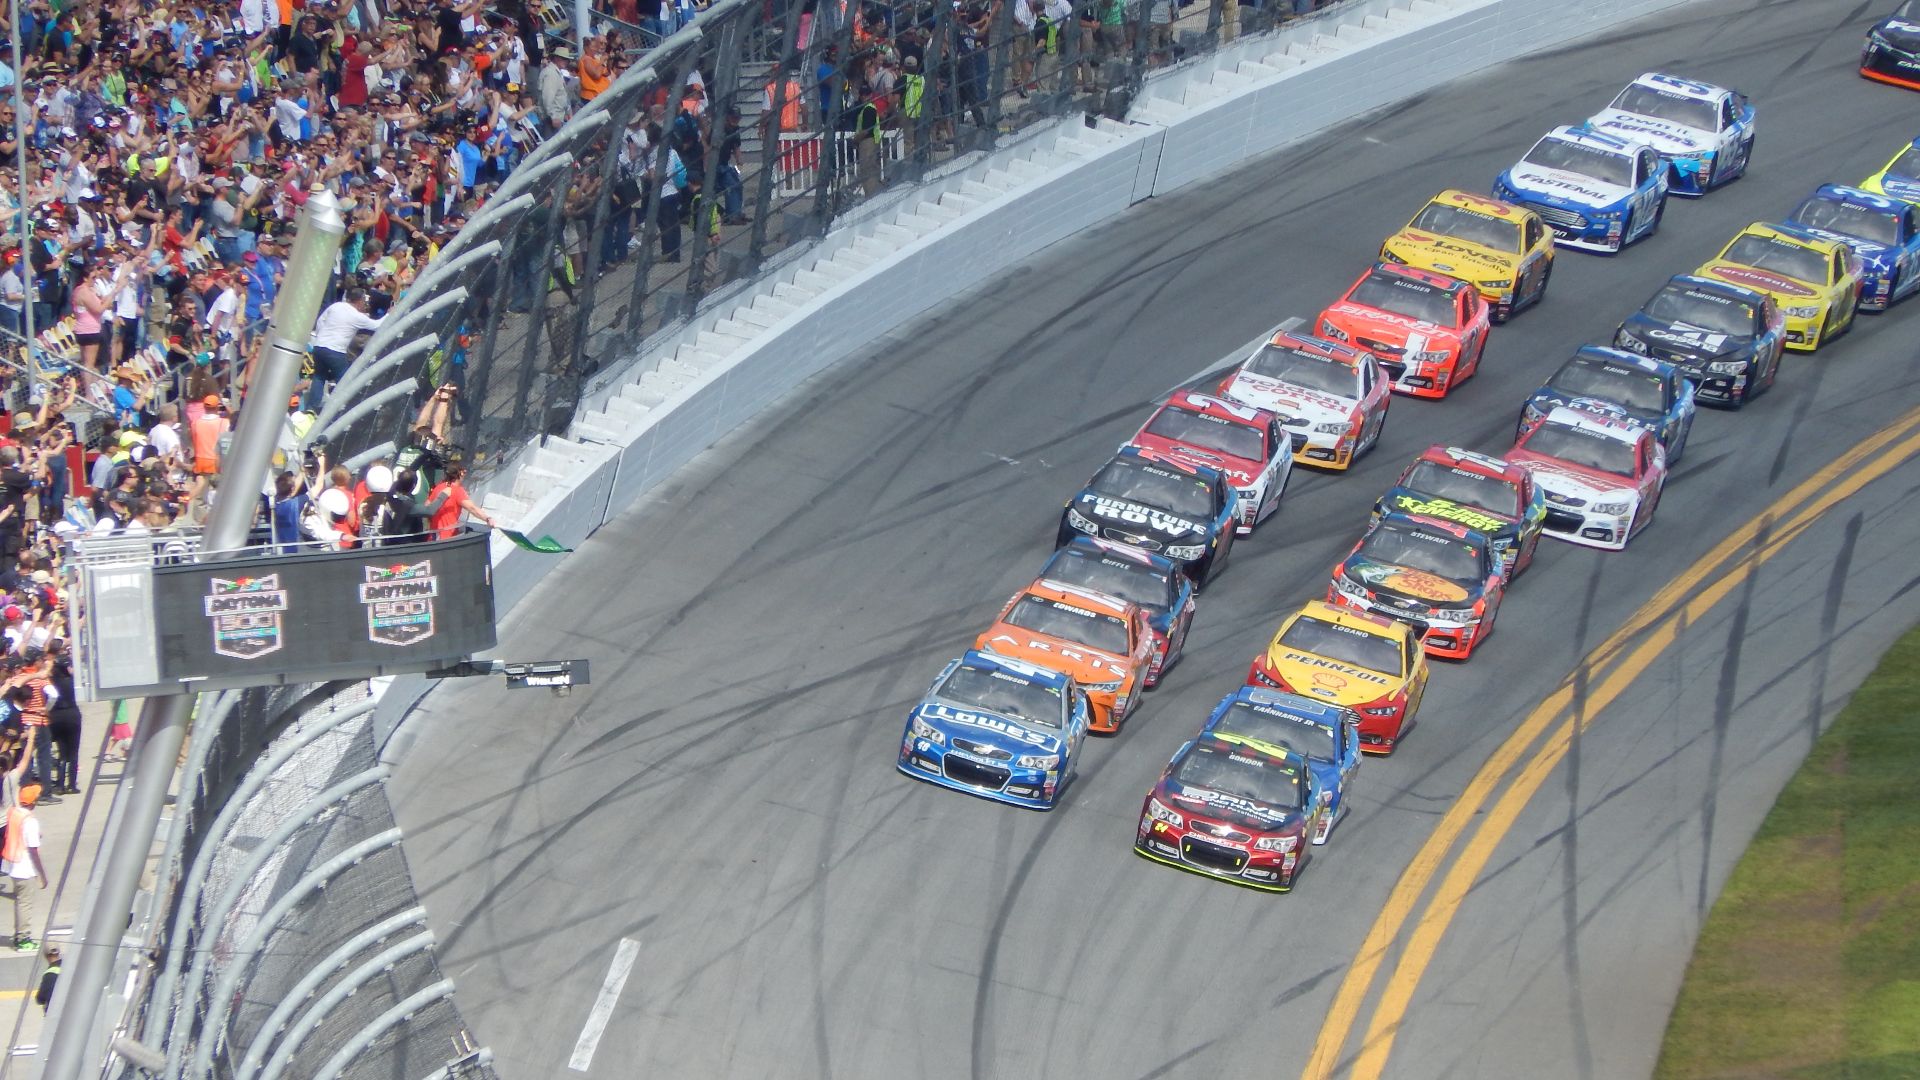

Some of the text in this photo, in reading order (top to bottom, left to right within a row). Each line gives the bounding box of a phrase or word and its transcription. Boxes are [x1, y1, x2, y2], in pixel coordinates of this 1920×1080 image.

[1615, 114, 1671, 131] Own
[1519, 172, 1609, 201] FASTENAL
[1394, 280, 1431, 293] ALLGAIER
[1650, 330, 1718, 352] Cessna
[1603, 366, 1631, 376] KAHNE
[1535, 395, 1656, 432] FARMERS
[1571, 426, 1609, 440] HARVICK
[1143, 466, 1169, 477] TRUEX
[1451, 468, 1486, 481] BOWYER
[1082, 493, 1207, 536] FURNITURE
[1093, 504, 1185, 536] ROW
[1414, 505, 1502, 531] ENERGY
[1410, 531, 1451, 545] STEWART
[1101, 558, 1131, 570] BIFFLE
[1053, 601, 1097, 619] EDWARDS
[1331, 624, 1369, 639] LOGANO
[991, 634, 1127, 679] ARRIS
[1284, 652, 1389, 686] PENNZOIL
[990, 671, 1030, 686] JOHNSON
[1253, 705, 1316, 727] EARNHARDT JR
[936, 706, 1046, 744] LOWE'S
[1228, 753, 1264, 767] GORDON
[1154, 821, 1168, 833] 24
